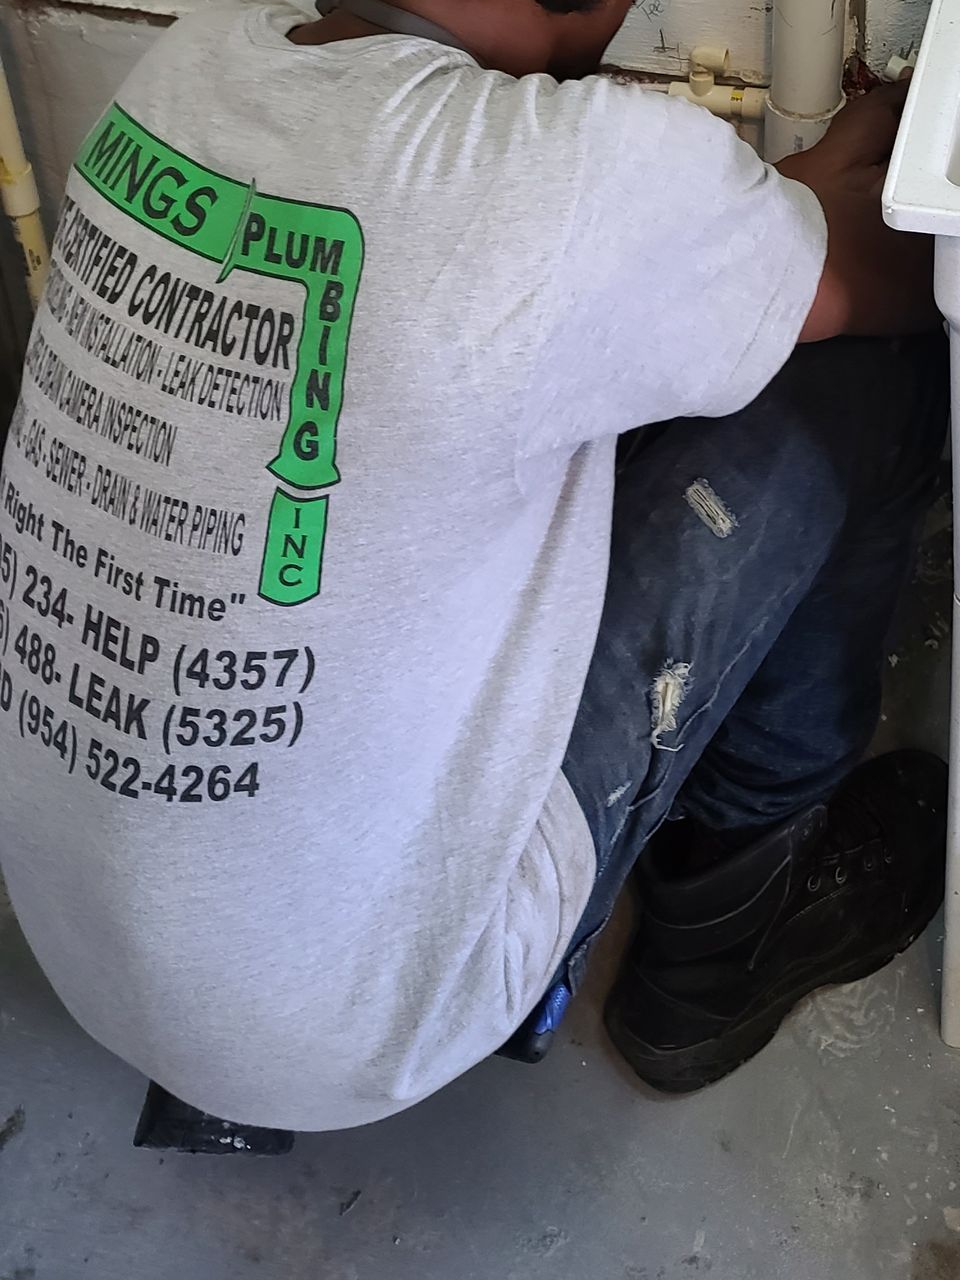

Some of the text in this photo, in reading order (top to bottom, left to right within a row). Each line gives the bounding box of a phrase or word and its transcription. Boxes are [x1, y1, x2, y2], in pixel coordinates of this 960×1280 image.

[84, 120, 219, 237] MINGS
[63, 207, 139, 305] CERTIFIED
[128, 264, 295, 370] CONTRACTOR
[100, 395, 179, 467] INSPECTION
[161, 351, 205, 403] LEAK
[197, 364, 286, 422] DETECTION
[4, 481, 45, 542] Right
[51, 520, 88, 569] The
[94, 547, 145, 602] First
[153, 577, 246, 622] Time"
[91, 464, 132, 521] DRAIN
[128, 484, 141, 526] &
[140, 488, 189, 545] WATER
[188, 504, 246, 557] PIPING
[277, 507, 308, 588] INC
[22, 564, 75, 629] 234-
[81, 604, 161, 676] HELP
[172, 644, 316, 696] (4357)
[14, 625, 62, 686] 488-
[68, 663, 152, 740] LEAK
[162, 701, 304, 755] (5325)
[19, 689, 78, 775] (954)
[85, 738, 260, 803] 522-4264
